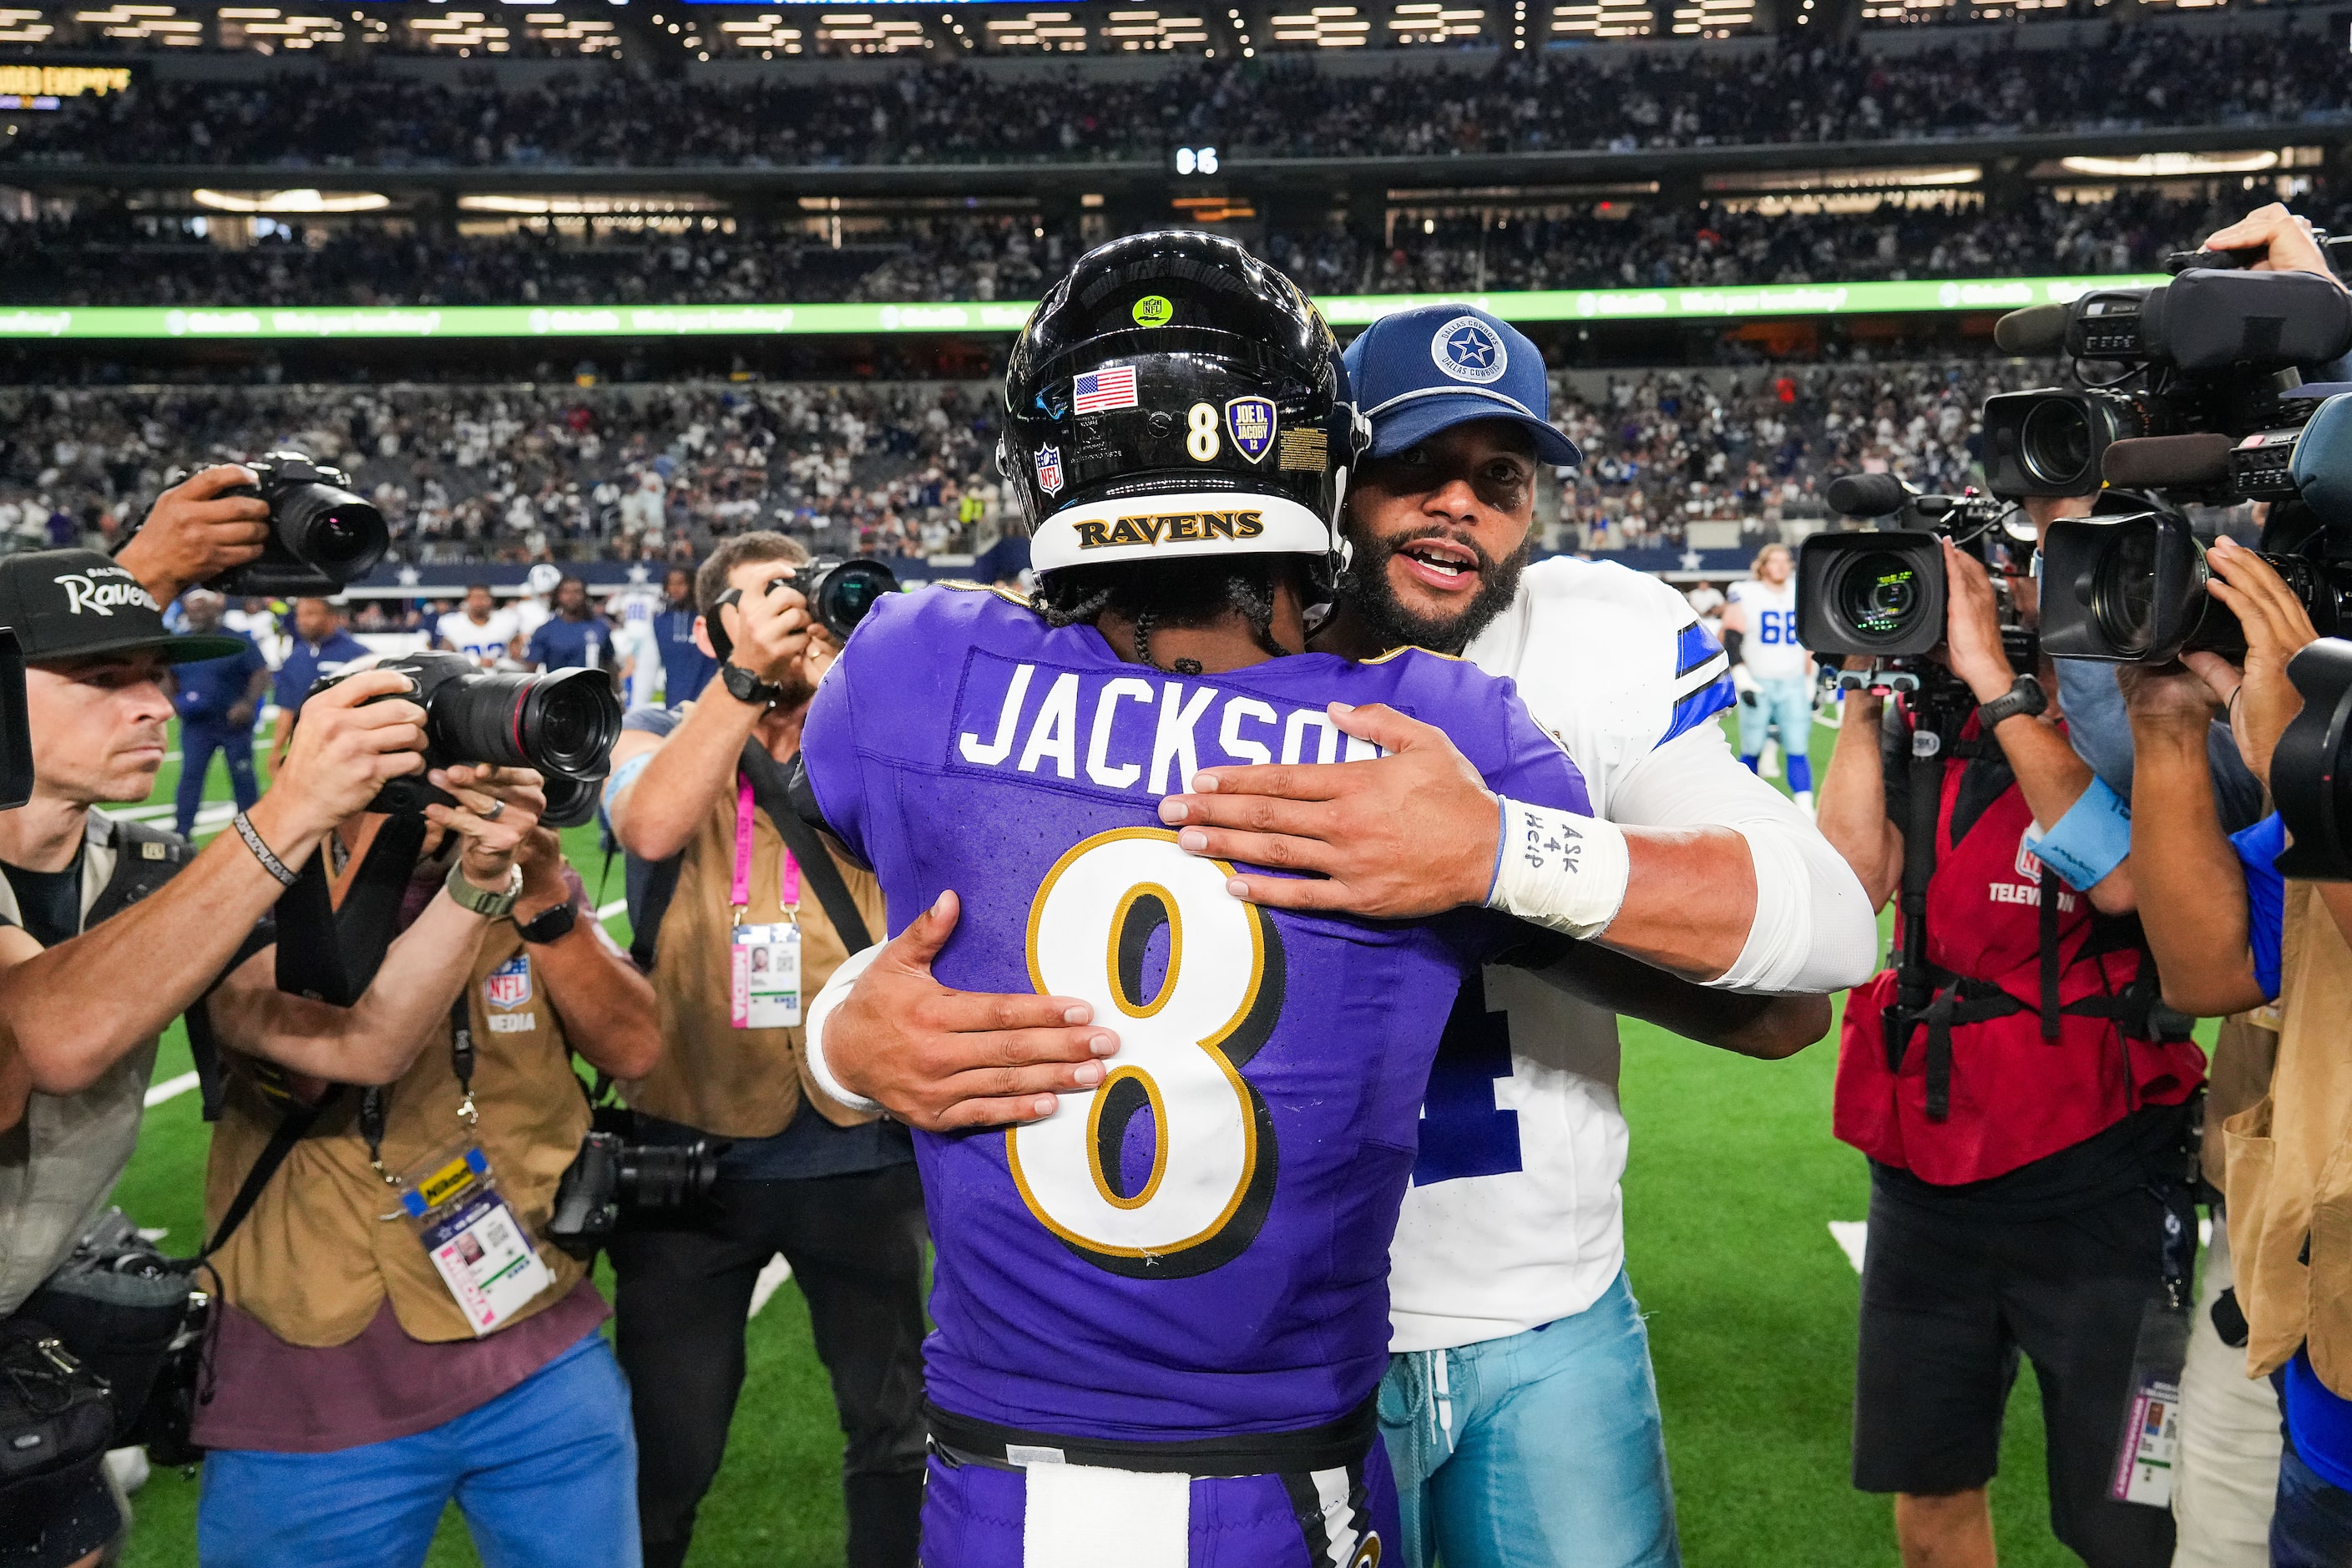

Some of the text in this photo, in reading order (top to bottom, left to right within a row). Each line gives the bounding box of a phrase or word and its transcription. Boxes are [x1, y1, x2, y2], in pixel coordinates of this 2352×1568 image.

[1441, 320, 1499, 346] DALLAS COWBOYS
[1442, 357, 1500, 377] DALLAS COWBOYS
[1237, 405, 1267, 423] JOE D.
[1186, 402, 1220, 462] 8
[1237, 424, 1268, 440] JACOBY
[2270, 434, 2294, 443] SONY
[1249, 439, 1259, 450] 12
[1039, 467, 1060, 488] NFL
[1072, 510, 1265, 549] RAVENS
[1544, 837, 1561, 852] 4
[1562, 824, 1583, 873] ASK
[489, 976, 524, 1001] NFL
[733, 951, 747, 1021] MEDIA
[1005, 826, 1287, 1280] 8
